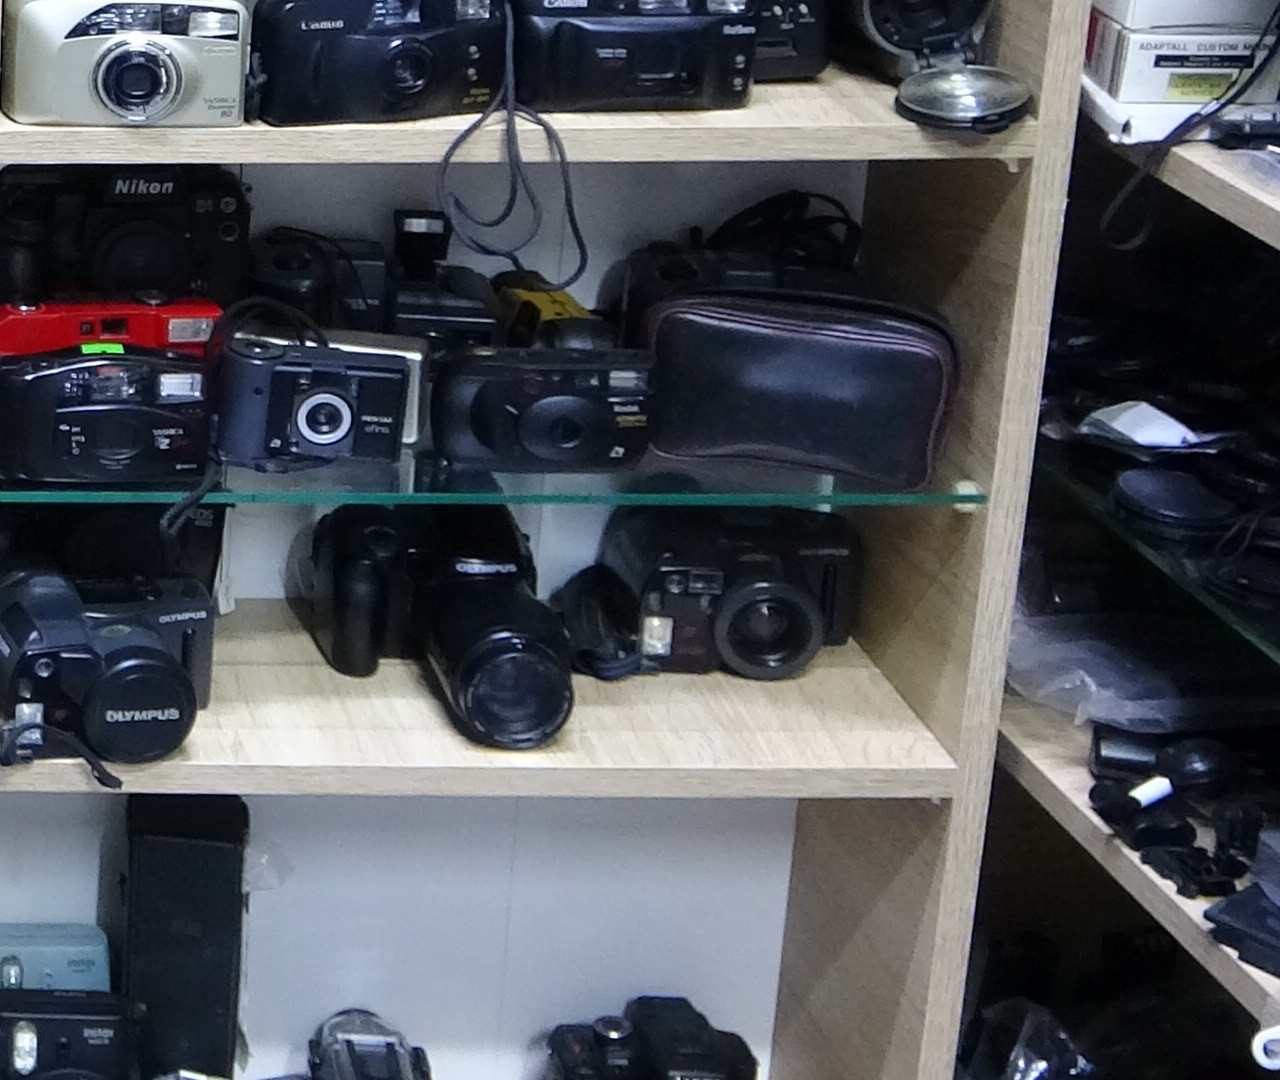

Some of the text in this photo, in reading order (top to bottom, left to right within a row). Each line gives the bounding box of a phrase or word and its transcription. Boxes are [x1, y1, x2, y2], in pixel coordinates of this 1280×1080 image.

[1139, 41, 1189, 51] ADAPTALL
[1196, 41, 1239, 52] CUSTOM
[114, 179, 175, 195] Nikon
[158, 610, 208, 624] OLYMPUS
[105, 707, 181, 724] OLYMPUS
